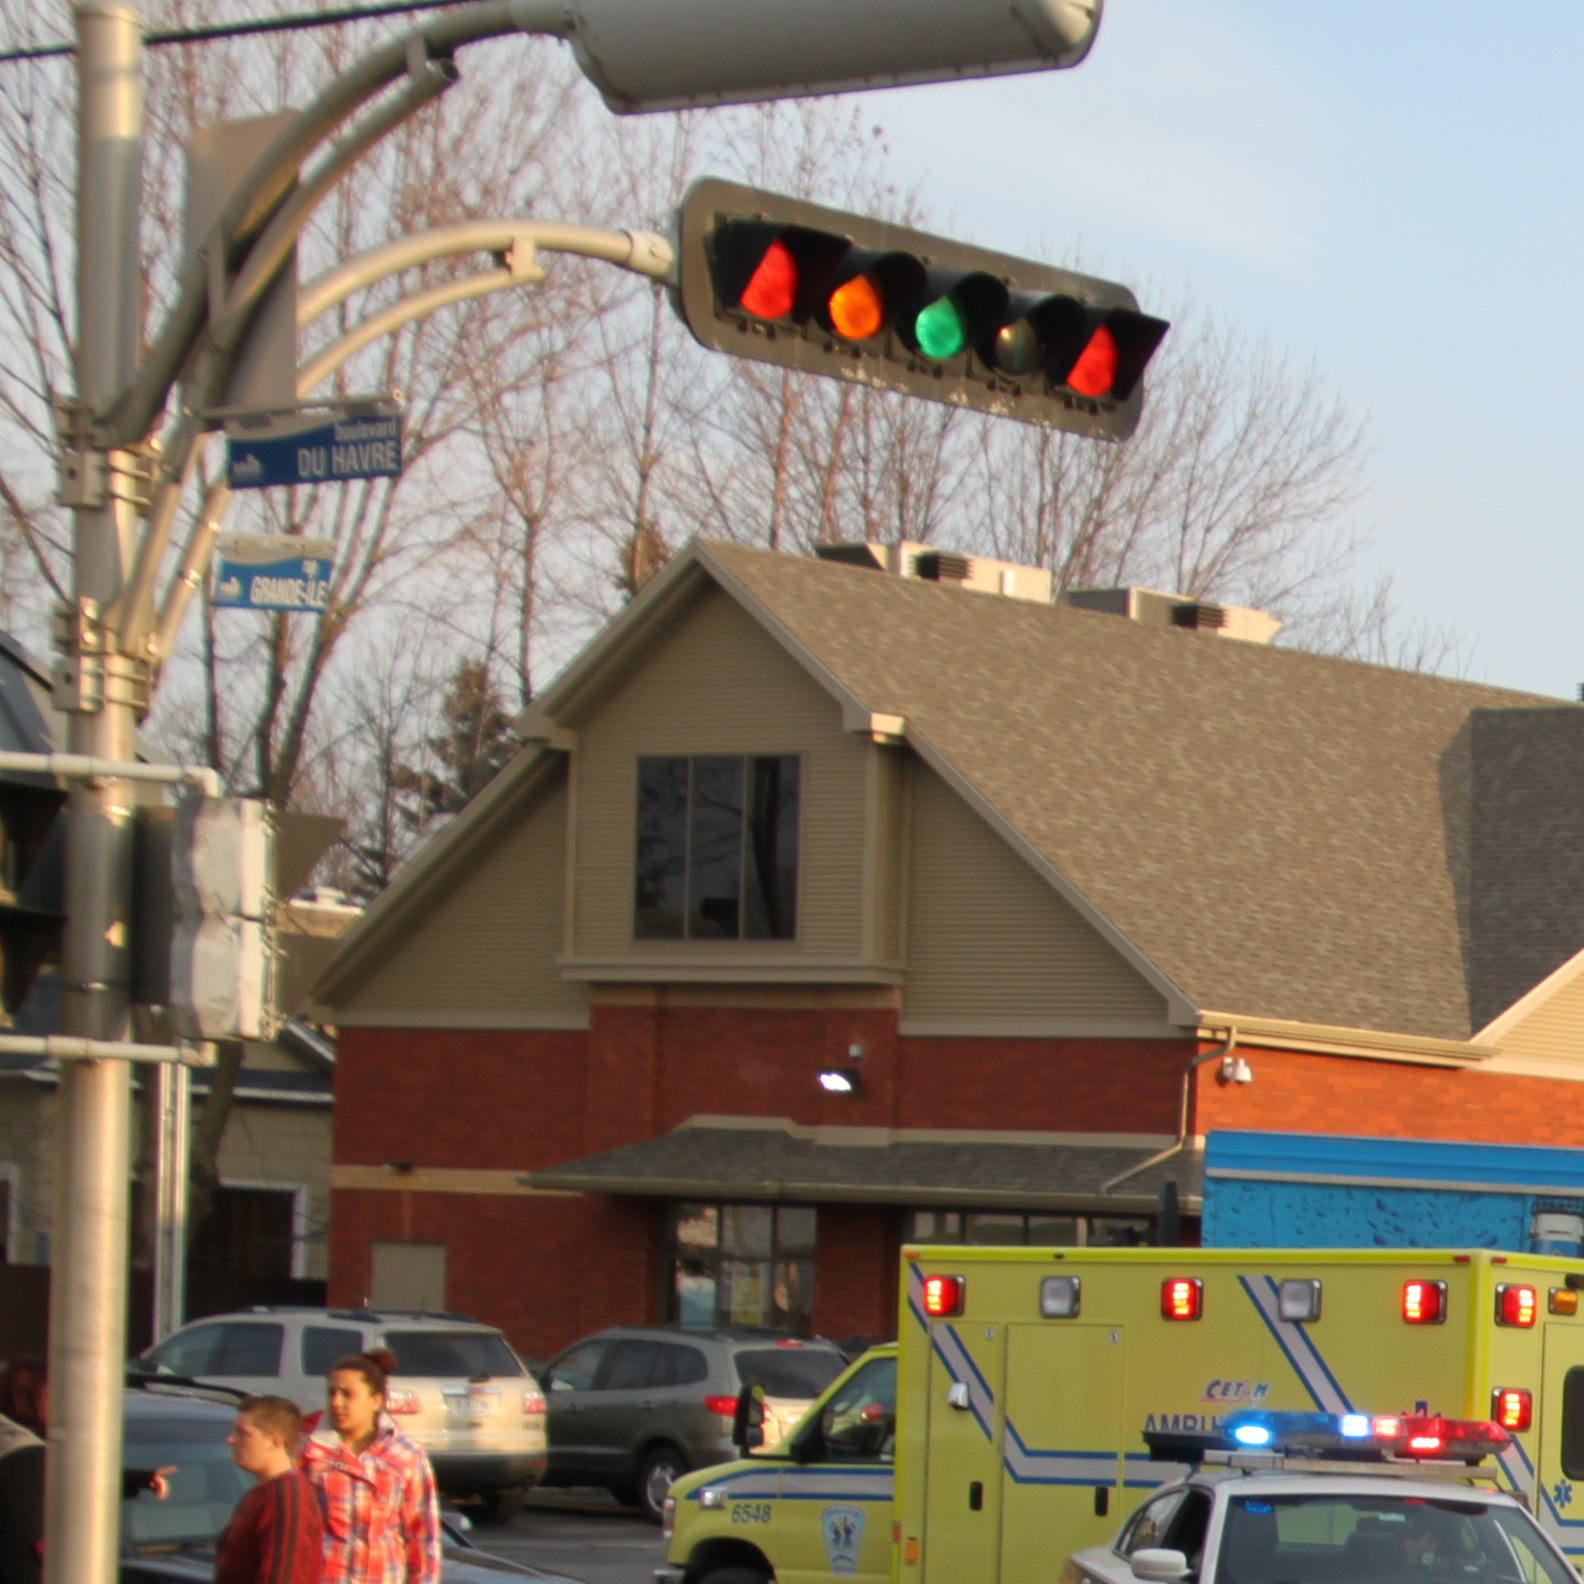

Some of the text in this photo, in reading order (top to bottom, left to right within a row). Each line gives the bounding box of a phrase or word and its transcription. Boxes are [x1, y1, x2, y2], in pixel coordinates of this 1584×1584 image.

[297, 446, 327, 478] DU
[331, 440, 398, 475] HAVRE
[731, 1504, 772, 1524] 6548
